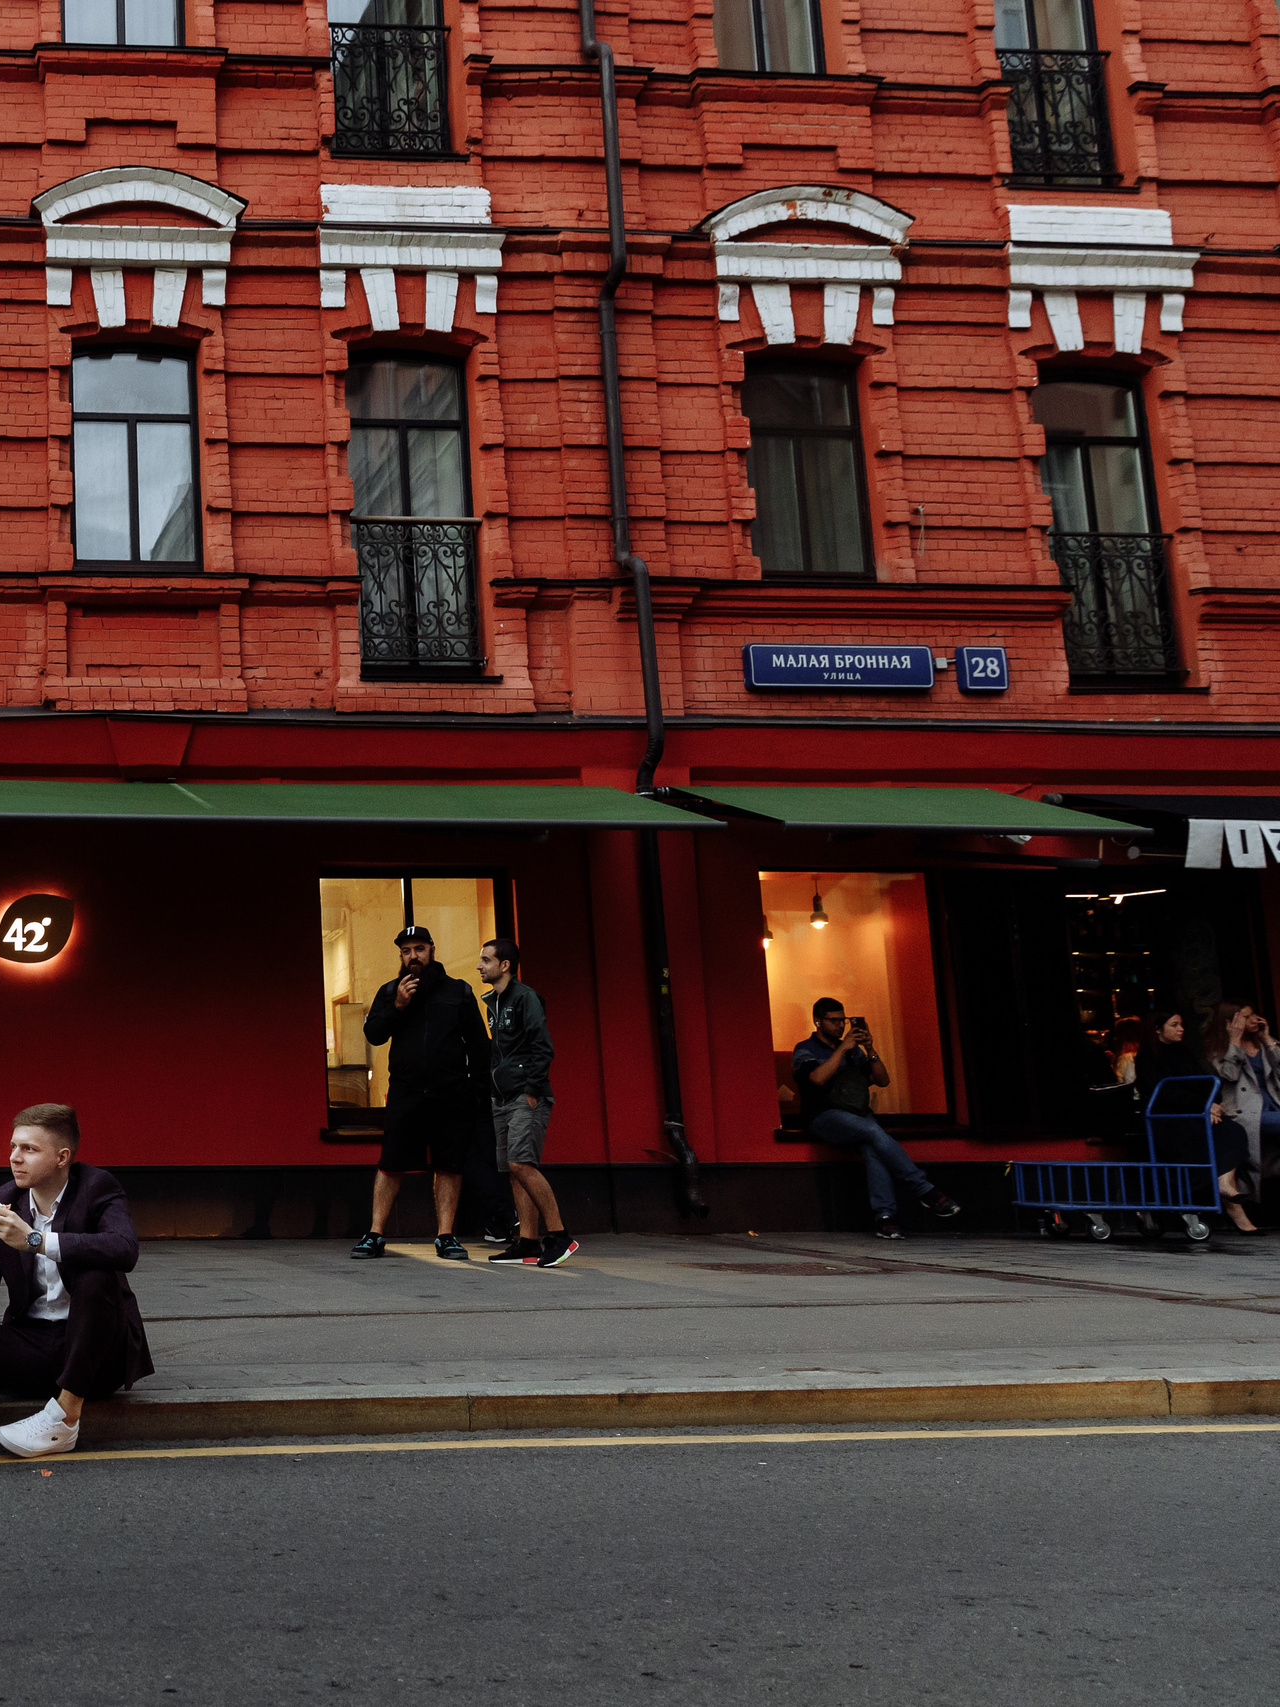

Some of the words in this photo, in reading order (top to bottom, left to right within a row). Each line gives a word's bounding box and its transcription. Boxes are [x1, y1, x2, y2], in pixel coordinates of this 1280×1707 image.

[771, 654, 828, 668] МАЛАЯ
[835, 655, 912, 669] БРОННАЯ
[971, 657, 1001, 678] 28
[823, 672, 862, 681] УЛИЦА
